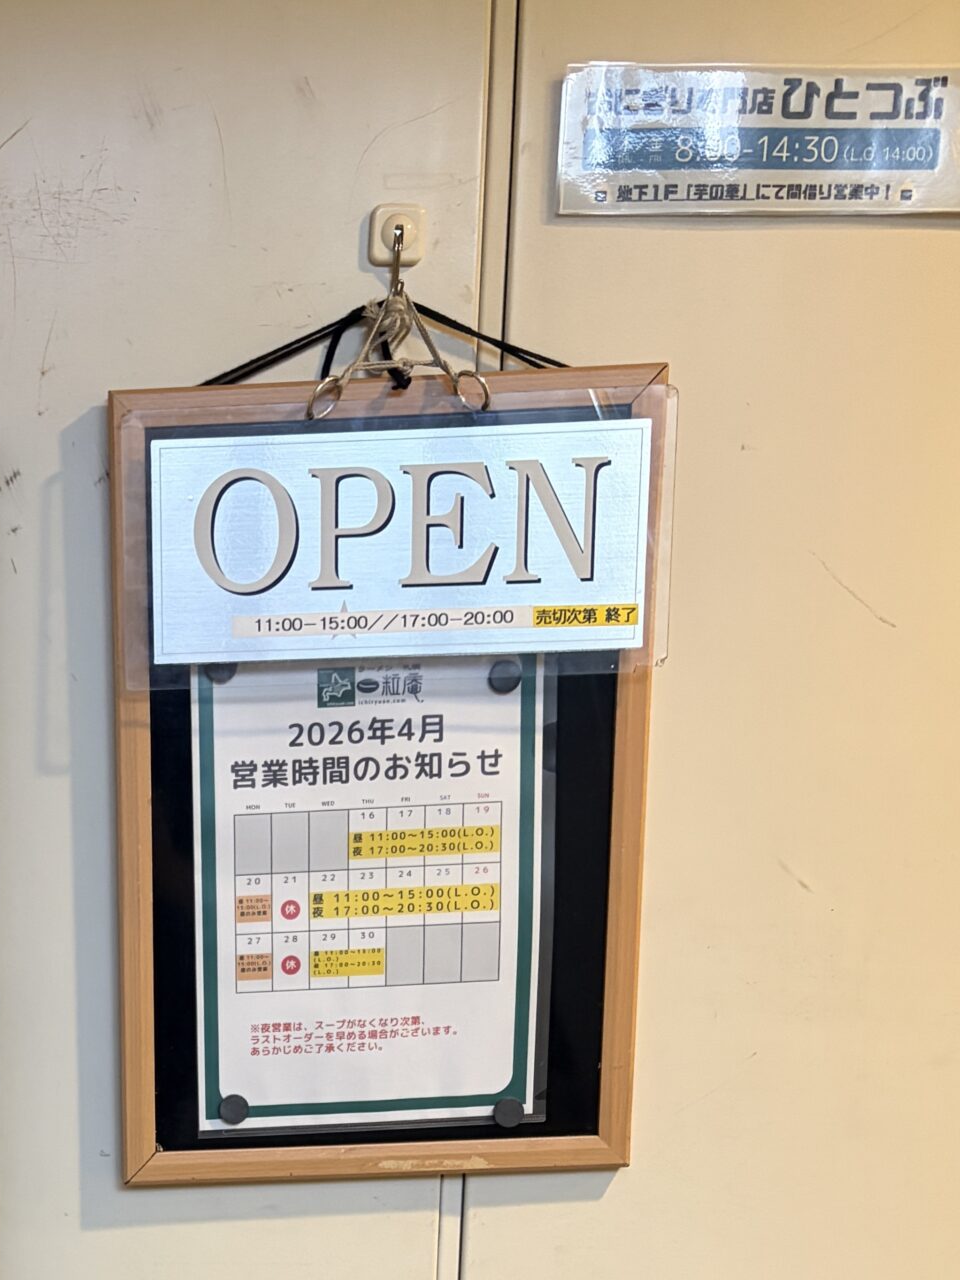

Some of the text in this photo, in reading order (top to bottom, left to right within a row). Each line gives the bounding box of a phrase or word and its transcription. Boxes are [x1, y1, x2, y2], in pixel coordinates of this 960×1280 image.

[781, 76, 948, 120] ひとつぶ
[193, 456, 611, 596] OPEN
[536, 608, 598, 625] 売切次第
[605, 607, 637, 623] 終了
[288, 714, 444, 747] 2026年4月
[230, 748, 503, 789] 営業時間のお知らせ
[360, 811, 375, 819] 16
[399, 809, 413, 817] 17
[352, 846, 363, 856] 夜
[284, 876, 297, 884] 21
[360, 872, 374, 880] 23
[398, 870, 412, 878] 24
[437, 868, 450, 876] 25
[475, 866, 489, 874] 26
[312, 906, 324, 918] 夜
[284, 935, 298, 943] 28
[251, 1016, 425, 1033] ※夜営業は、スープがなくなり次第、
[251, 1026, 458, 1044] ラストオーダーを早める場合がございます。
[251, 1042, 383, 1056] あらかじめご了承ください。
